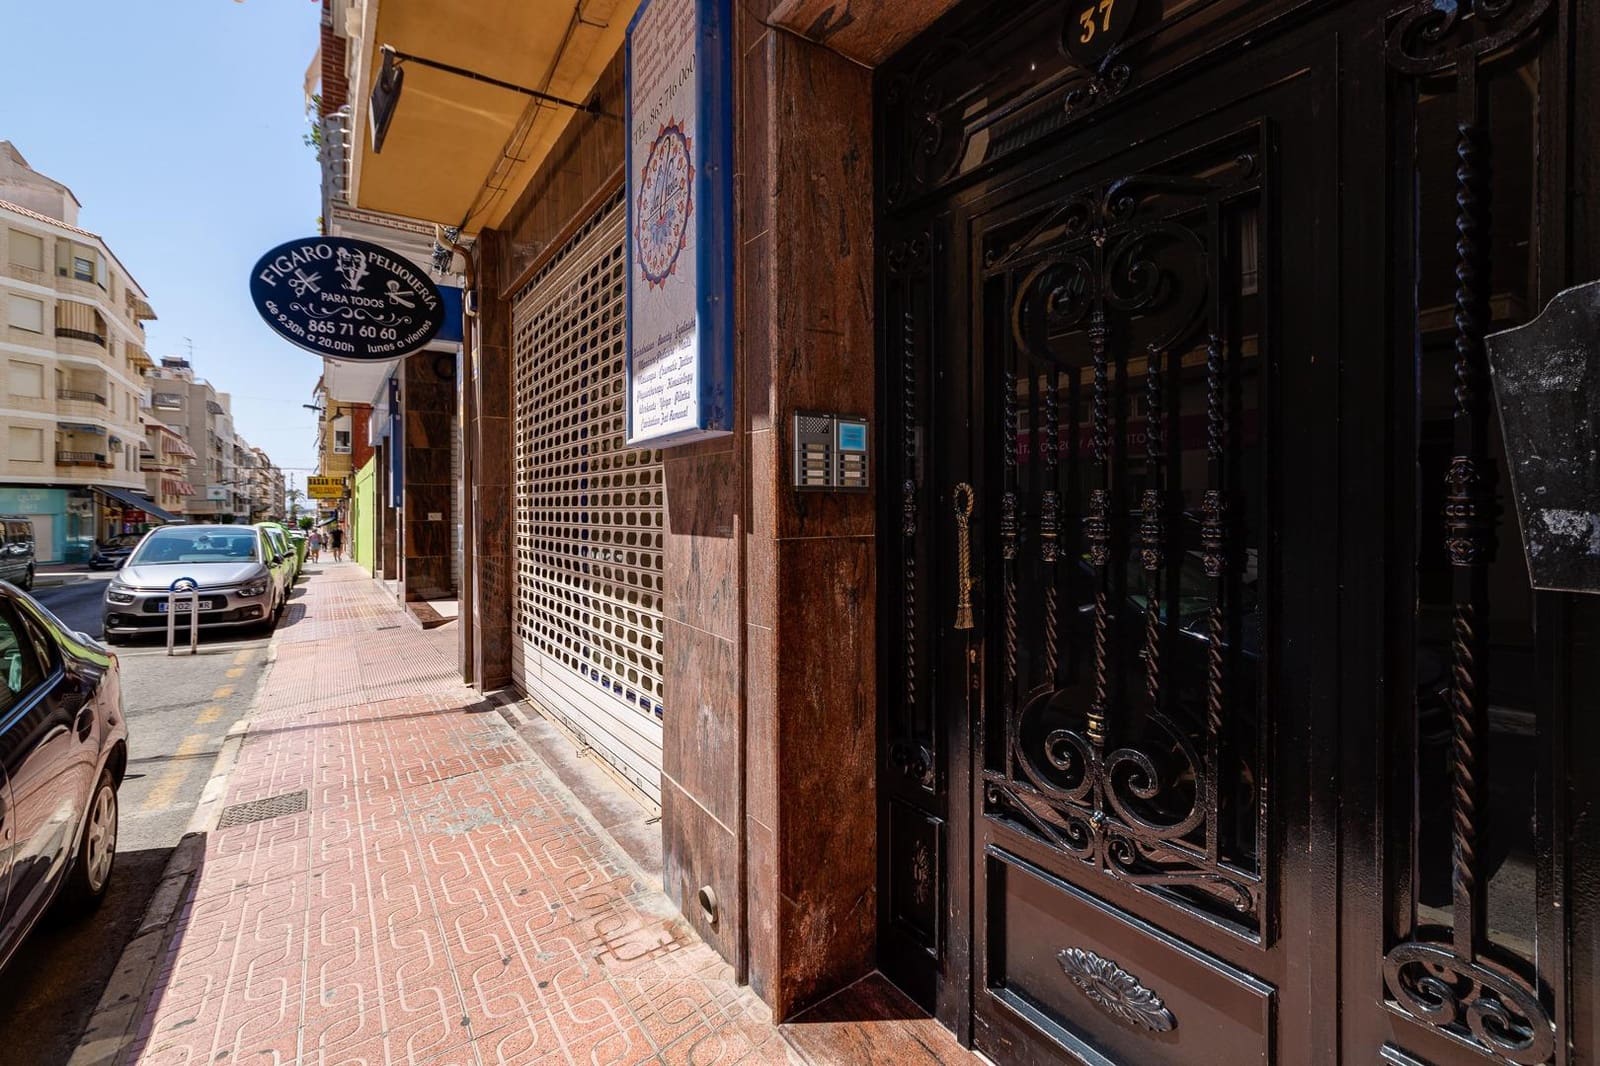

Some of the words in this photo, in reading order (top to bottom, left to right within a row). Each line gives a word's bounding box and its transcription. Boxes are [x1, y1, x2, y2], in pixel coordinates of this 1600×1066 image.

[1080, 0, 1114, 43] 37
[260, 244, 332, 287] FIGARO
[368, 252, 437, 311] PELUQUERÍA
[321, 292, 349, 304] PARA
[350, 296, 385, 308] TODOS
[265, 300, 279, 315] de
[307, 334, 316, 342] a
[318, 336, 355, 352] 20.00h
[308, 320, 335, 334] 865
[339, 323, 354, 336] 71
[359, 325, 376, 338] 60
[380, 327, 397, 340] 60
[367, 344, 395, 353] lunes
[396, 341, 405, 349] a
[404, 320, 432, 344] viernes
